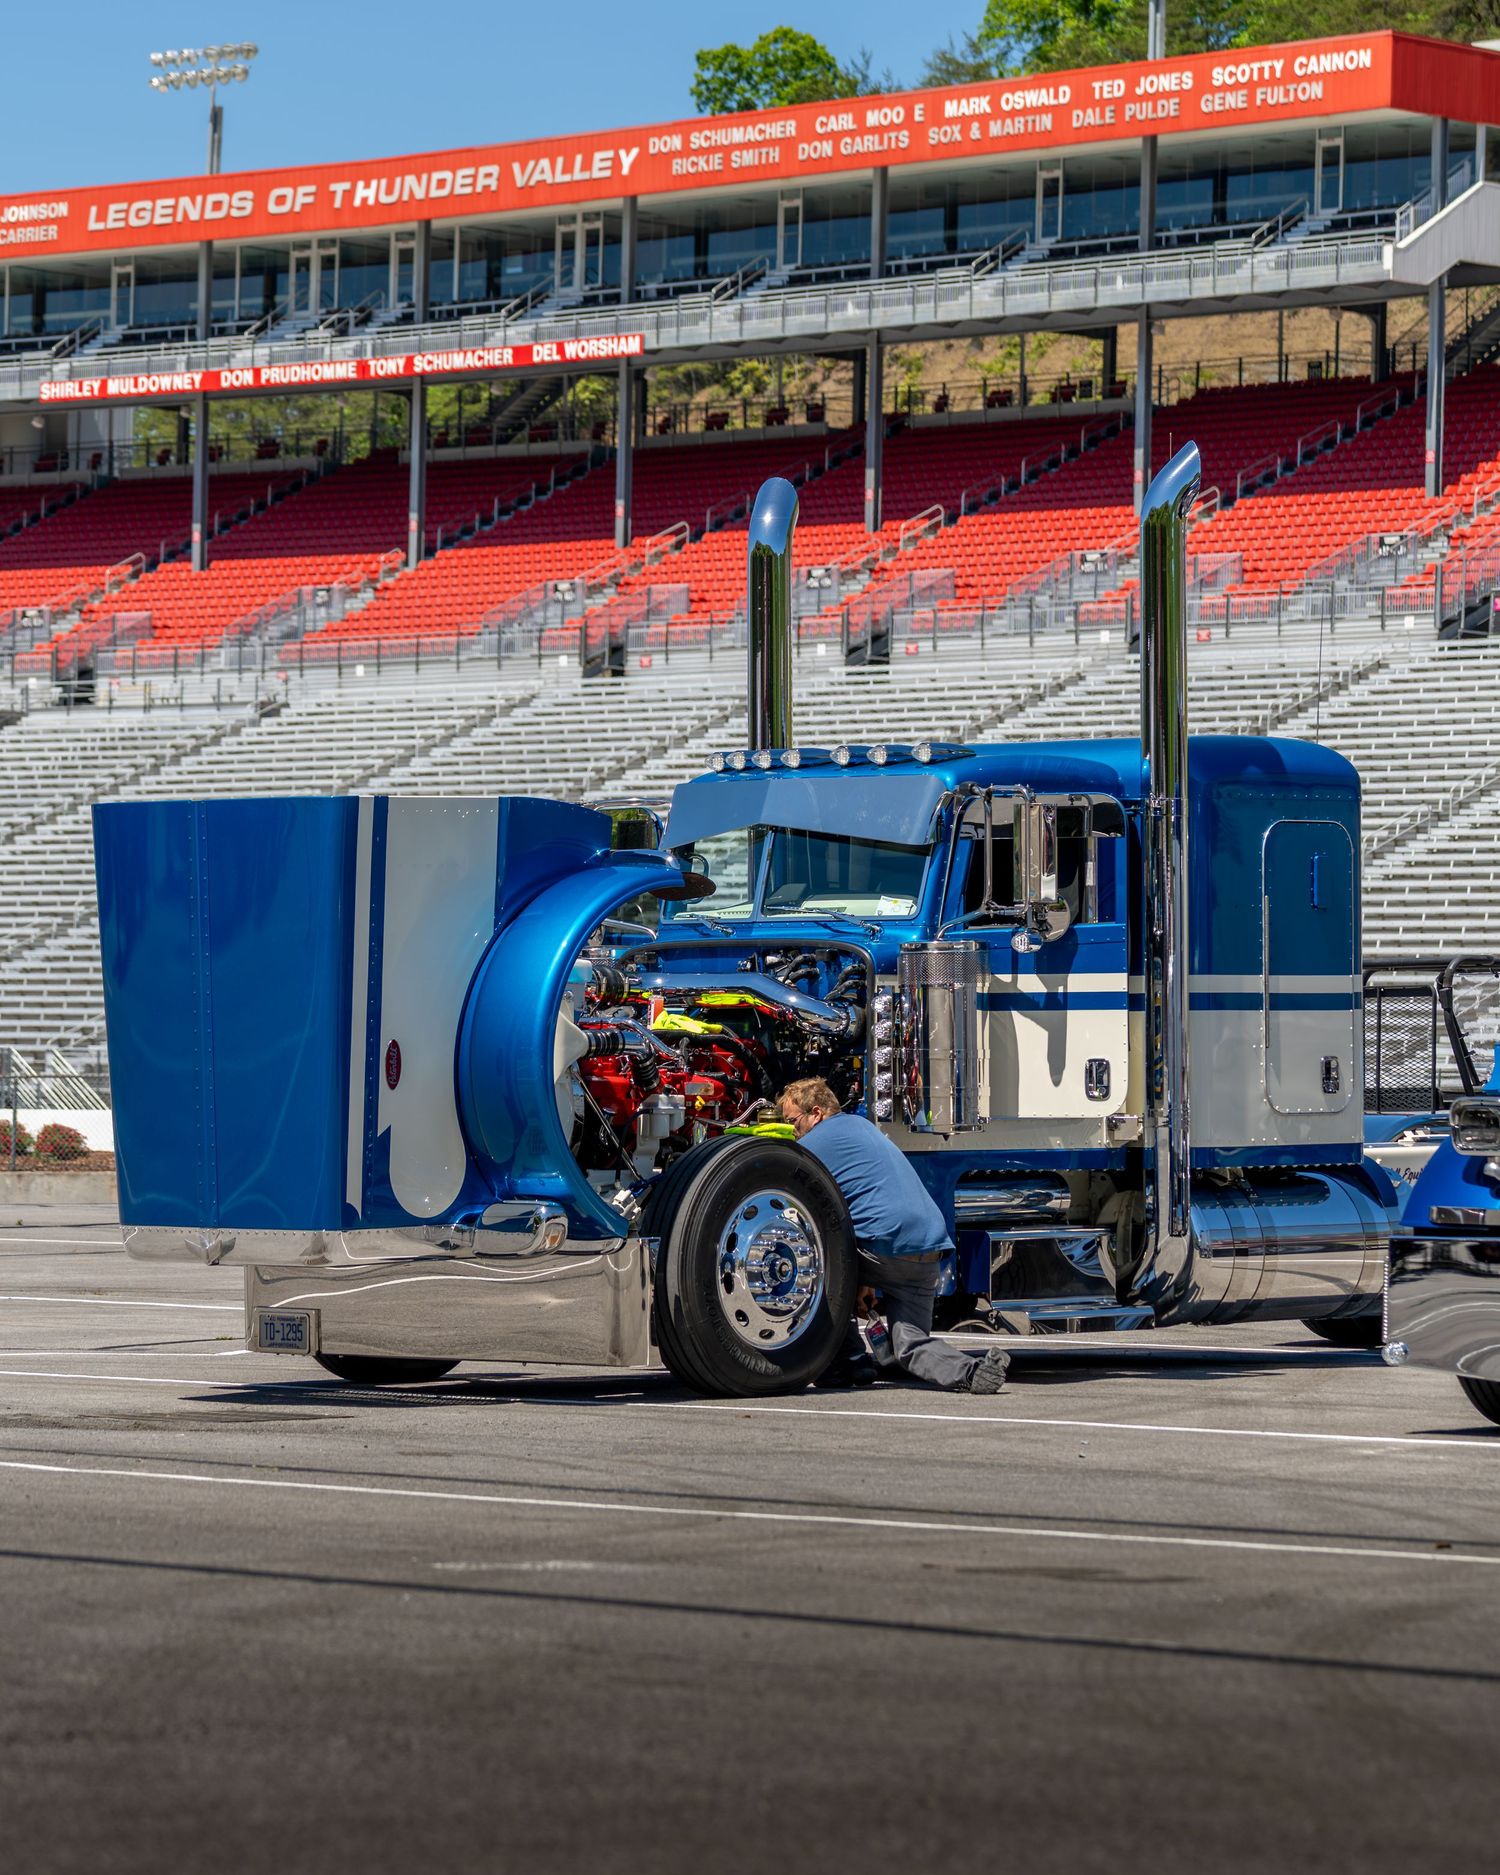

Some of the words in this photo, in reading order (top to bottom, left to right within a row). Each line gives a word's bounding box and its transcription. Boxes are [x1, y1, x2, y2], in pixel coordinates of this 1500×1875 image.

[1212, 58, 1284, 87] SCOTTY
[1294, 48, 1372, 76] CANNON
[1091, 79, 1126, 100] TED
[1135, 71, 1193, 95] JONES
[1200, 90, 1248, 113] GENE
[1255, 80, 1324, 106] FULTON
[943, 95, 992, 118] MARK
[1000, 85, 1071, 110] OSWALD
[1072, 106, 1116, 129] DALE
[1124, 98, 1180, 122] PULDE
[649, 133, 683, 155] DON
[689, 120, 797, 149] SCHUMACHER
[815, 112, 859, 135] CARL
[928, 124, 963, 146] SOX
[969, 121, 982, 140] &
[988, 113, 1052, 138] MARTIN
[672, 152, 724, 175] RICKIE
[730, 146, 781, 169] SMITH
[798, 140, 834, 161] DON
[840, 130, 910, 156] GARLITS
[88, 191, 255, 231] LEGENDS
[267, 185, 316, 214] OF
[329, 164, 500, 208] THUNDER
[511, 146, 640, 187] VALLEY
[0, 201, 68, 223] JOHNSON
[368, 357, 406, 377] TONY
[412, 347, 514, 372] SCHUMACHER
[532, 343, 562, 363] DEL
[563, 335, 640, 359] WORSHAM
[40, 379, 102, 400] SHIRLEY
[107, 371, 202, 394] MULDOWNEY
[220, 368, 254, 388] DON
[260, 361, 357, 384] PRUDHOMME
